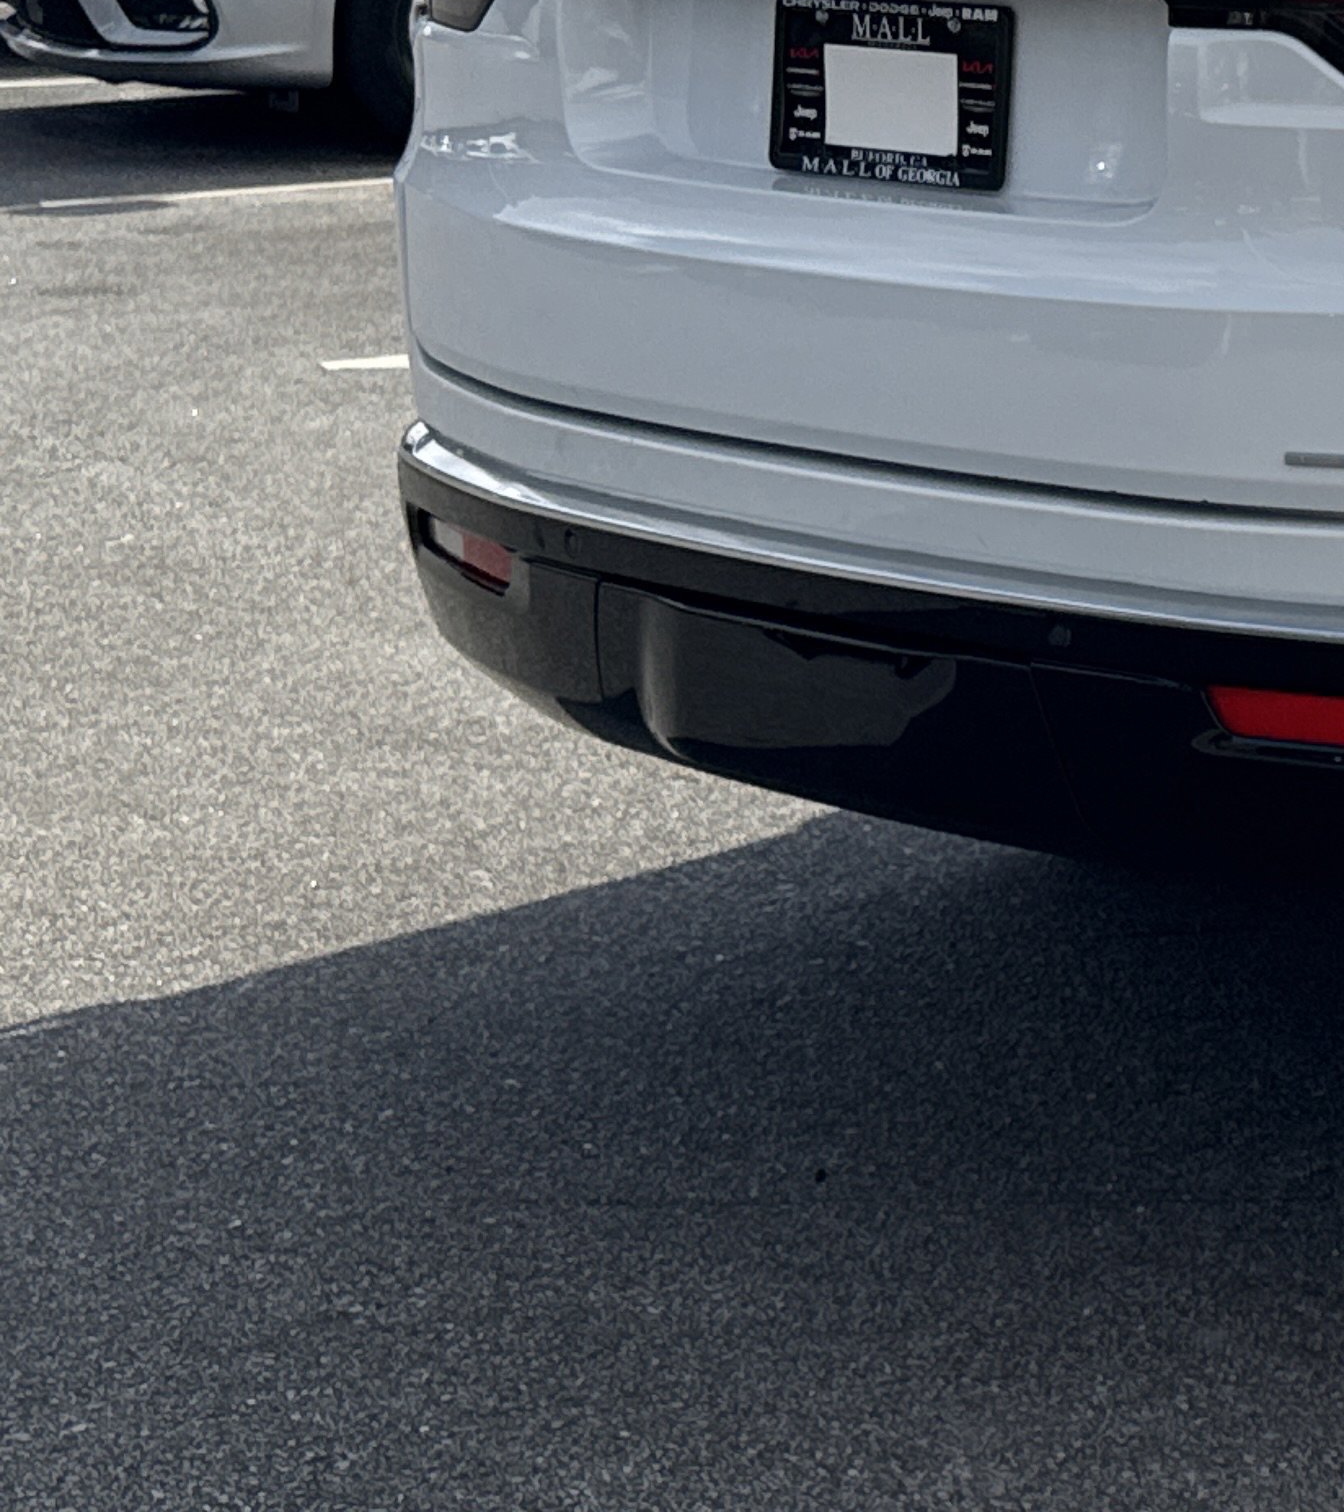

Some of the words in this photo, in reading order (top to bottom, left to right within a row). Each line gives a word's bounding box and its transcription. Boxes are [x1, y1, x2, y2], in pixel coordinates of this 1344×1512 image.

[868, 2, 920, 16] DODGE
[961, 6, 999, 22] RAM
[874, 164, 894, 180] OF
[897, 166, 961, 187] GEORGIA
